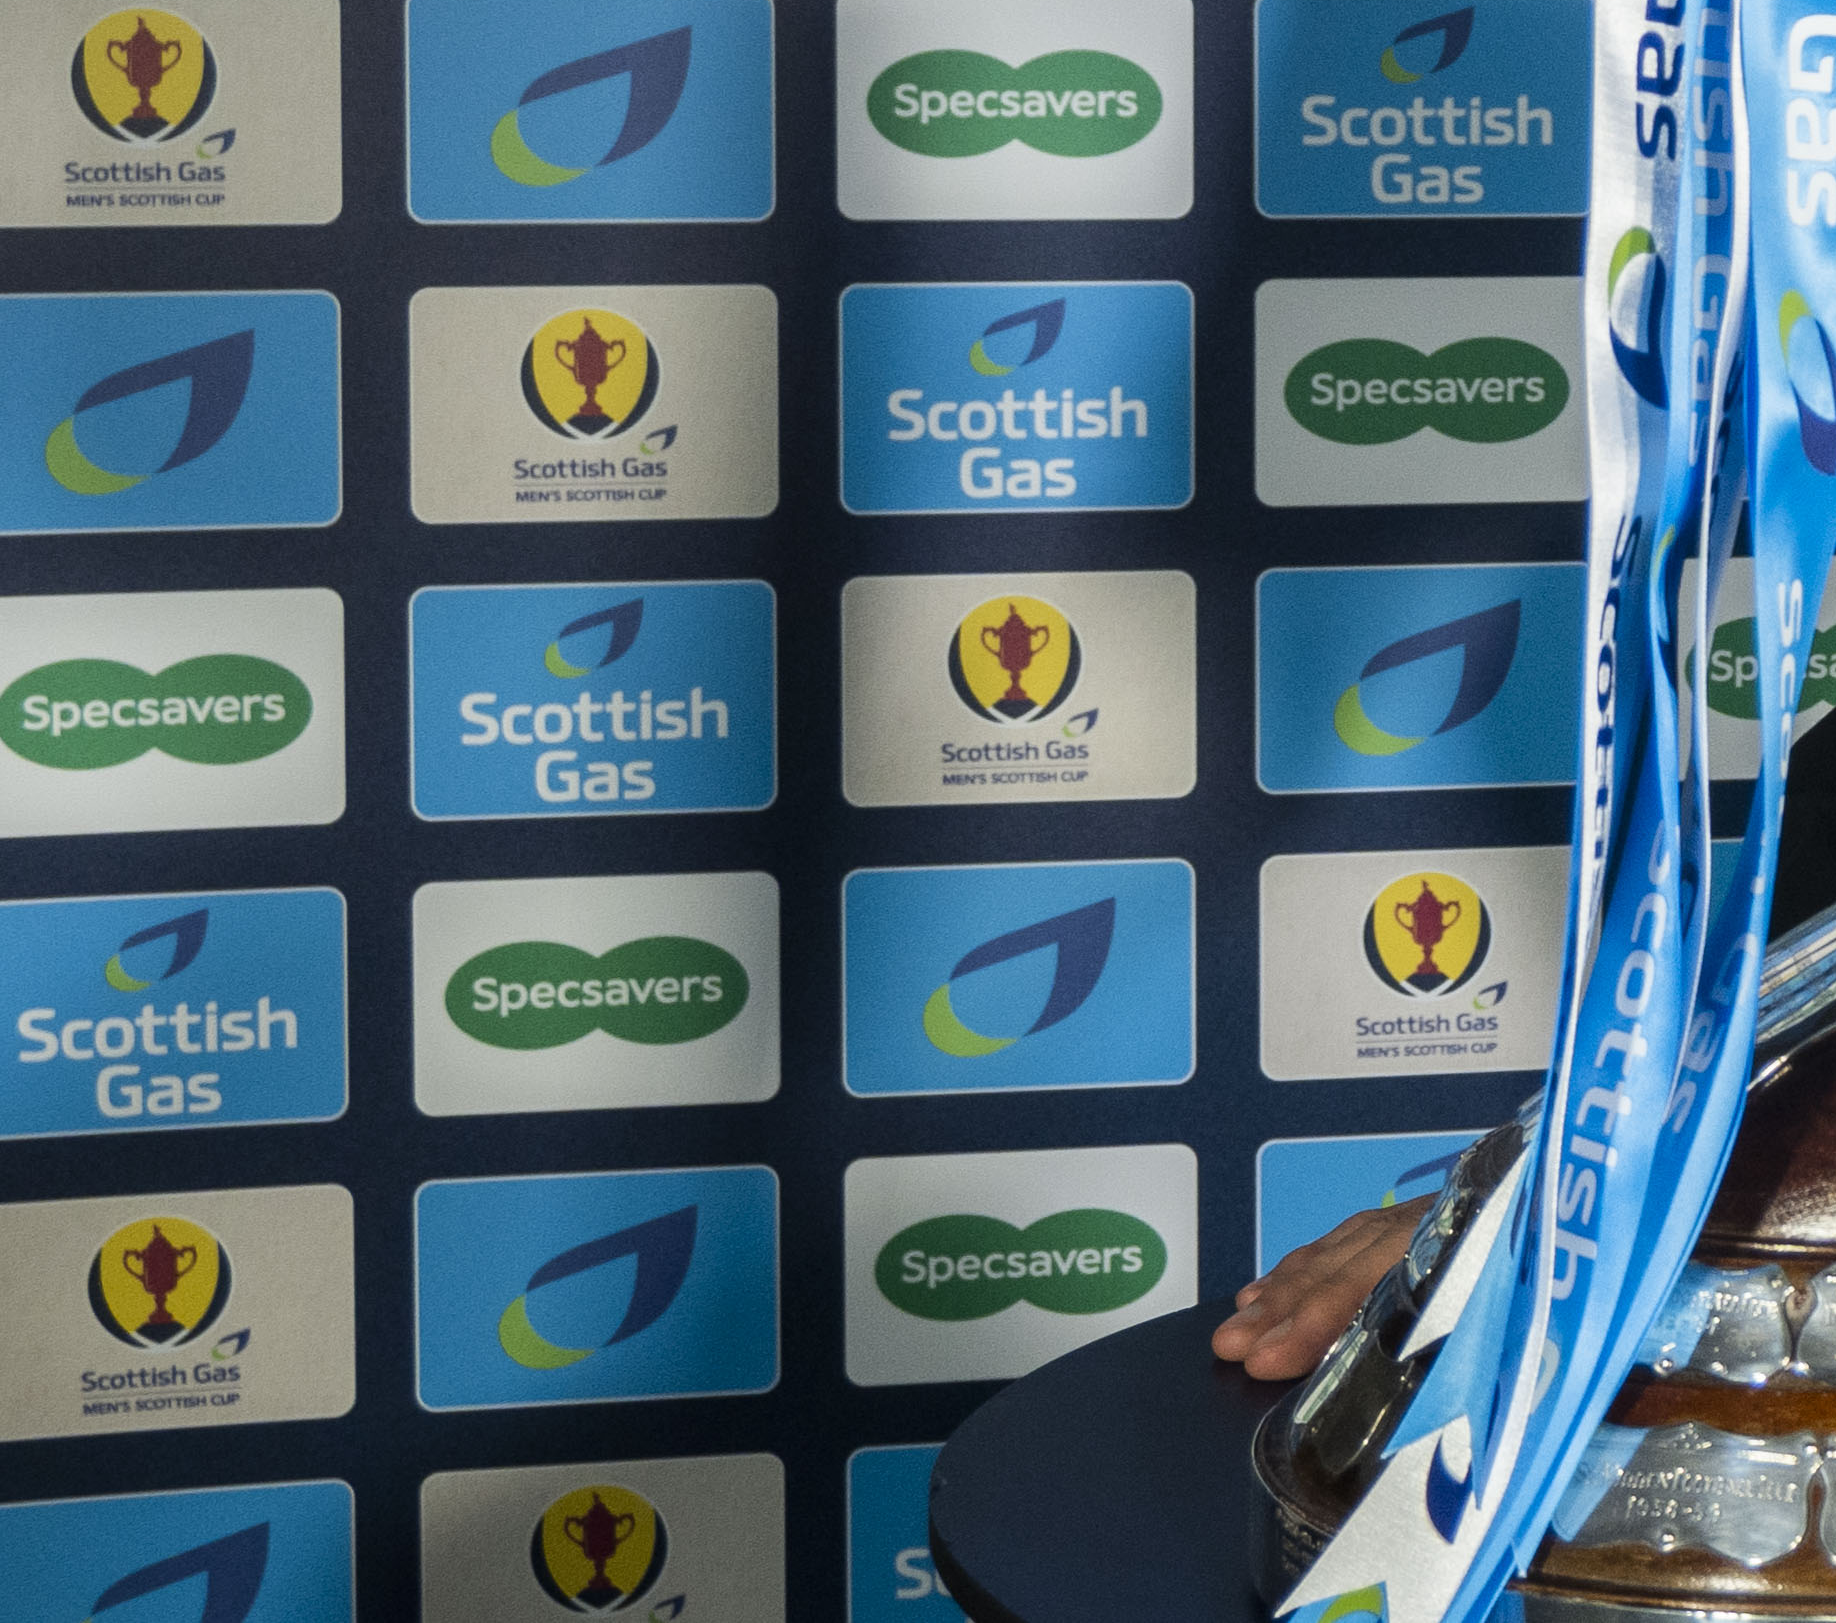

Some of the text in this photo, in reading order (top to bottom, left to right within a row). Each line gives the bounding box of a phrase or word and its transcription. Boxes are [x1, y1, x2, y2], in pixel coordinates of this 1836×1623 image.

[894, 82, 1139, 125] Specsavers
[1299, 93, 1555, 148] Scottish
[64, 161, 226, 183] Scottish Gas
[1369, 151, 1486, 206] Gas
[119, 193, 192, 207] SCOTTISH
[1311, 373, 1545, 411] Specsavers
[887, 384, 1149, 443] Scottish
[513, 456, 669, 480] Scottish Gas
[958, 446, 1079, 500] Gas
[565, 488, 635, 503] SCOTTISH
[23, 692, 287, 737] Specsavers
[457, 686, 729, 748] Scottish
[940, 739, 1090, 764] Scottish Gas
[532, 747, 657, 805] Gas
[991, 770, 1058, 786] SCOTTISH
[473, 973, 723, 1016] Specsavers
[15, 994, 299, 1065] Scottish
[1355, 1010, 1499, 1037] Scottish Gas
[1403, 1043, 1468, 1058] SCOTTISH
[94, 1062, 224, 1120] Gas
[901, 1245, 1143, 1287] Specsavers
[81, 1363, 241, 1392] Scottish Gas
[135, 1394, 207, 1412] SCOTTISH
